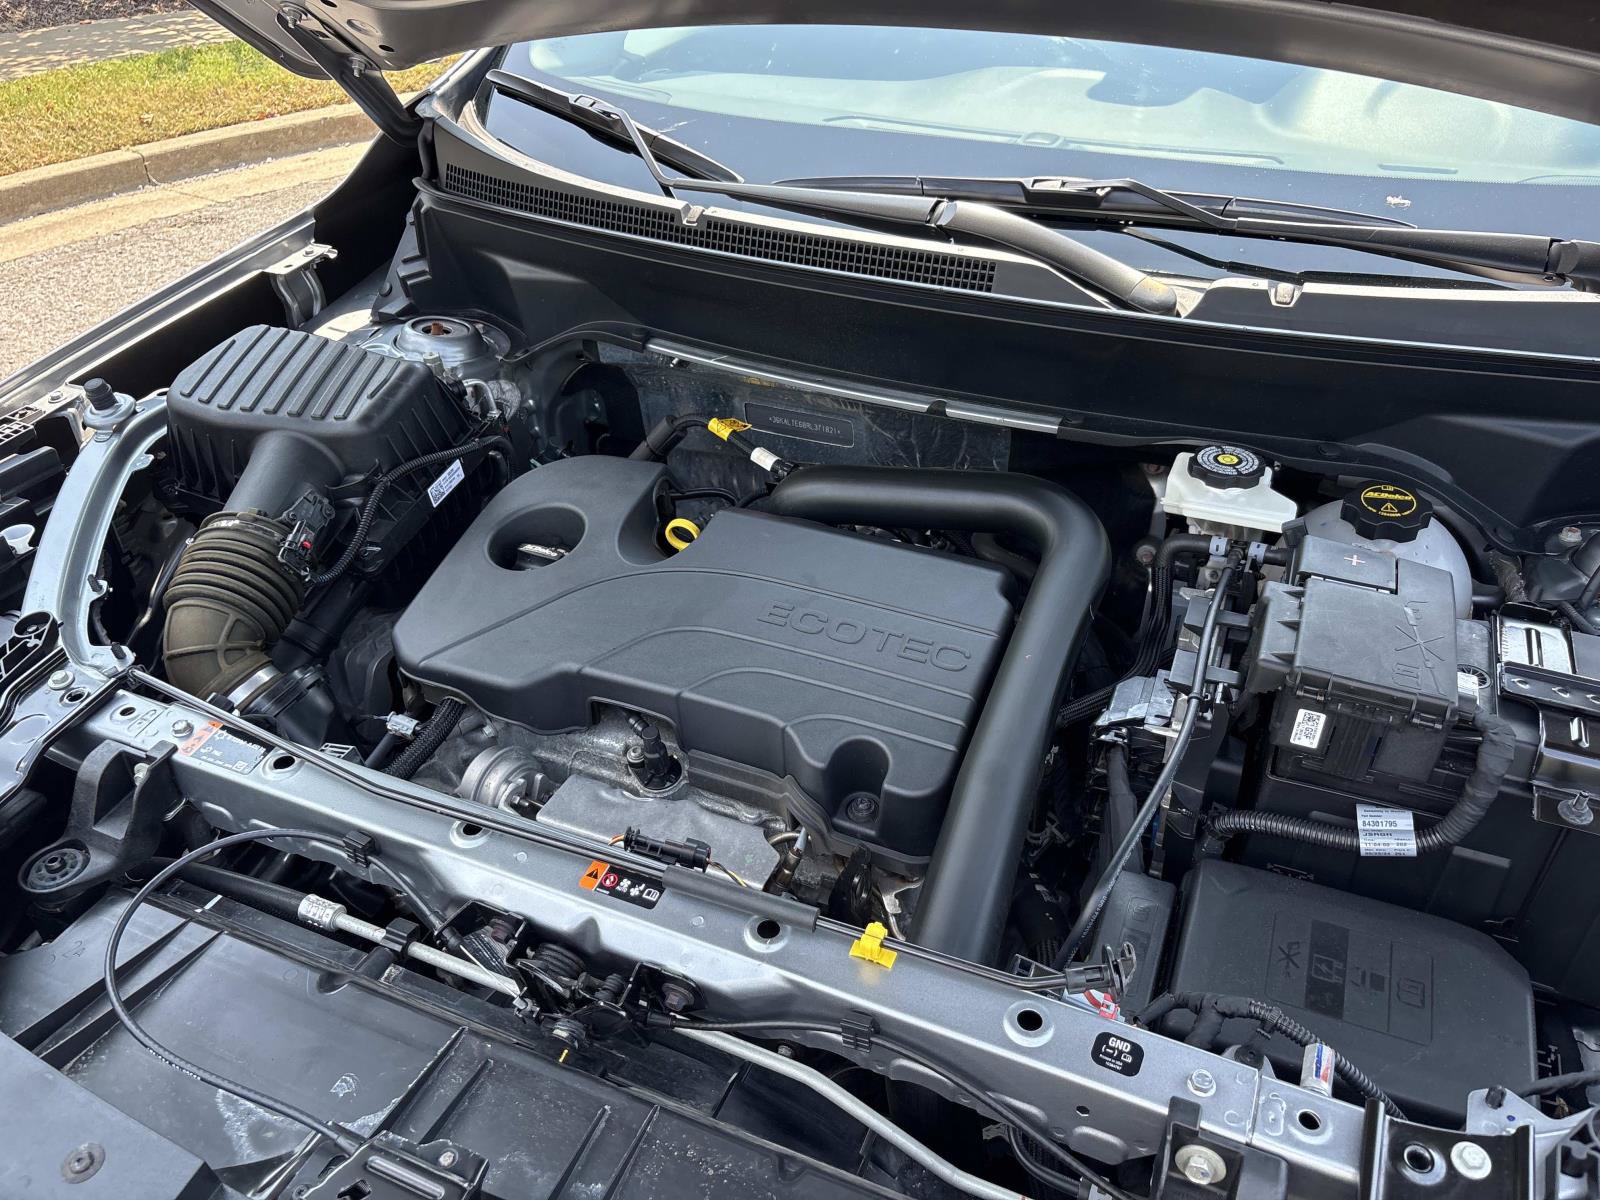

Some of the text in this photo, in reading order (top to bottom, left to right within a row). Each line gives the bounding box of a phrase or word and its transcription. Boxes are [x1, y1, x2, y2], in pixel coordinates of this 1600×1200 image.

[1364, 491, 1412, 501] ACDelco
[757, 600, 972, 672] ECOTEC
[1108, 1037, 1131, 1052] GND
